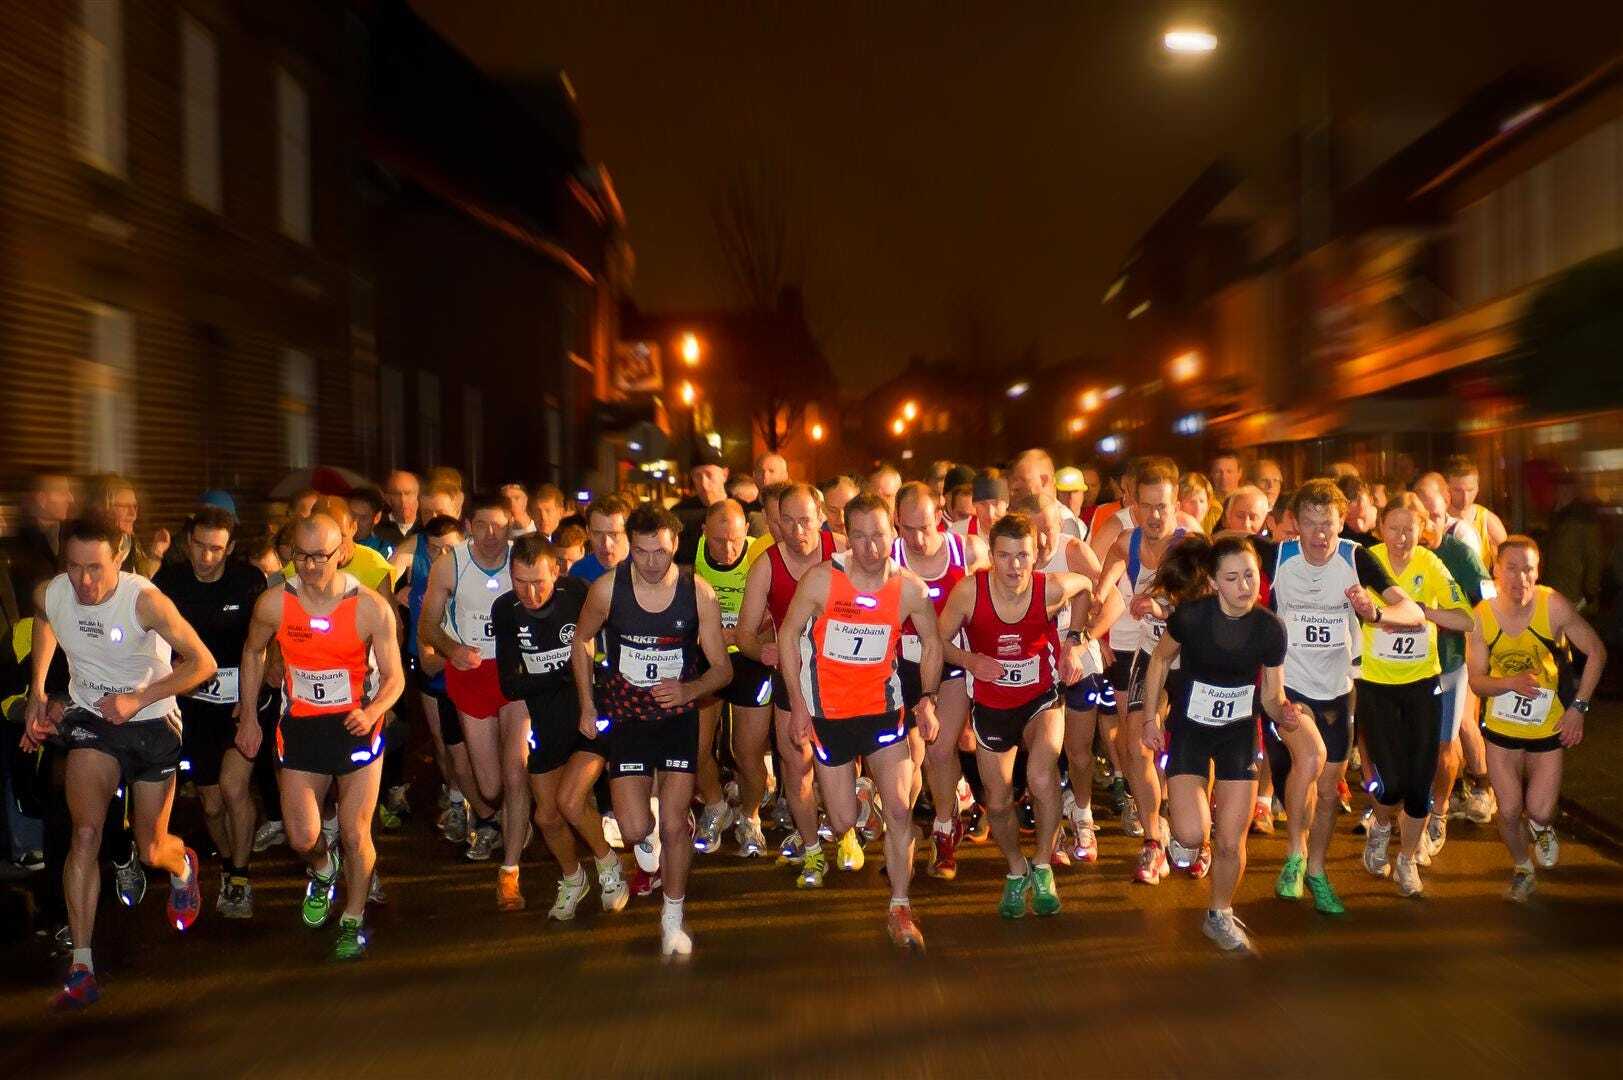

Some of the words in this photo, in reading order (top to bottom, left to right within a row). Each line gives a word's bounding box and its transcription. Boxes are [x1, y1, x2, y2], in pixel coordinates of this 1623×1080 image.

[1301, 614, 1344, 625] Rabobank
[484, 622, 496, 637] 6
[841, 625, 885, 635] Rabobank
[1305, 625, 1331, 643] 65
[852, 636, 863, 656] 7
[1392, 637, 1415, 655] 42
[634, 652, 680, 662] Rabobank
[300, 671, 344, 681] Rabobank
[645, 663, 658, 680] 8
[312, 682, 326, 700] 6
[1207, 689, 1249, 699] Rabobank
[1211, 699, 1235, 718] 81
[1512, 695, 1533, 717] 75
